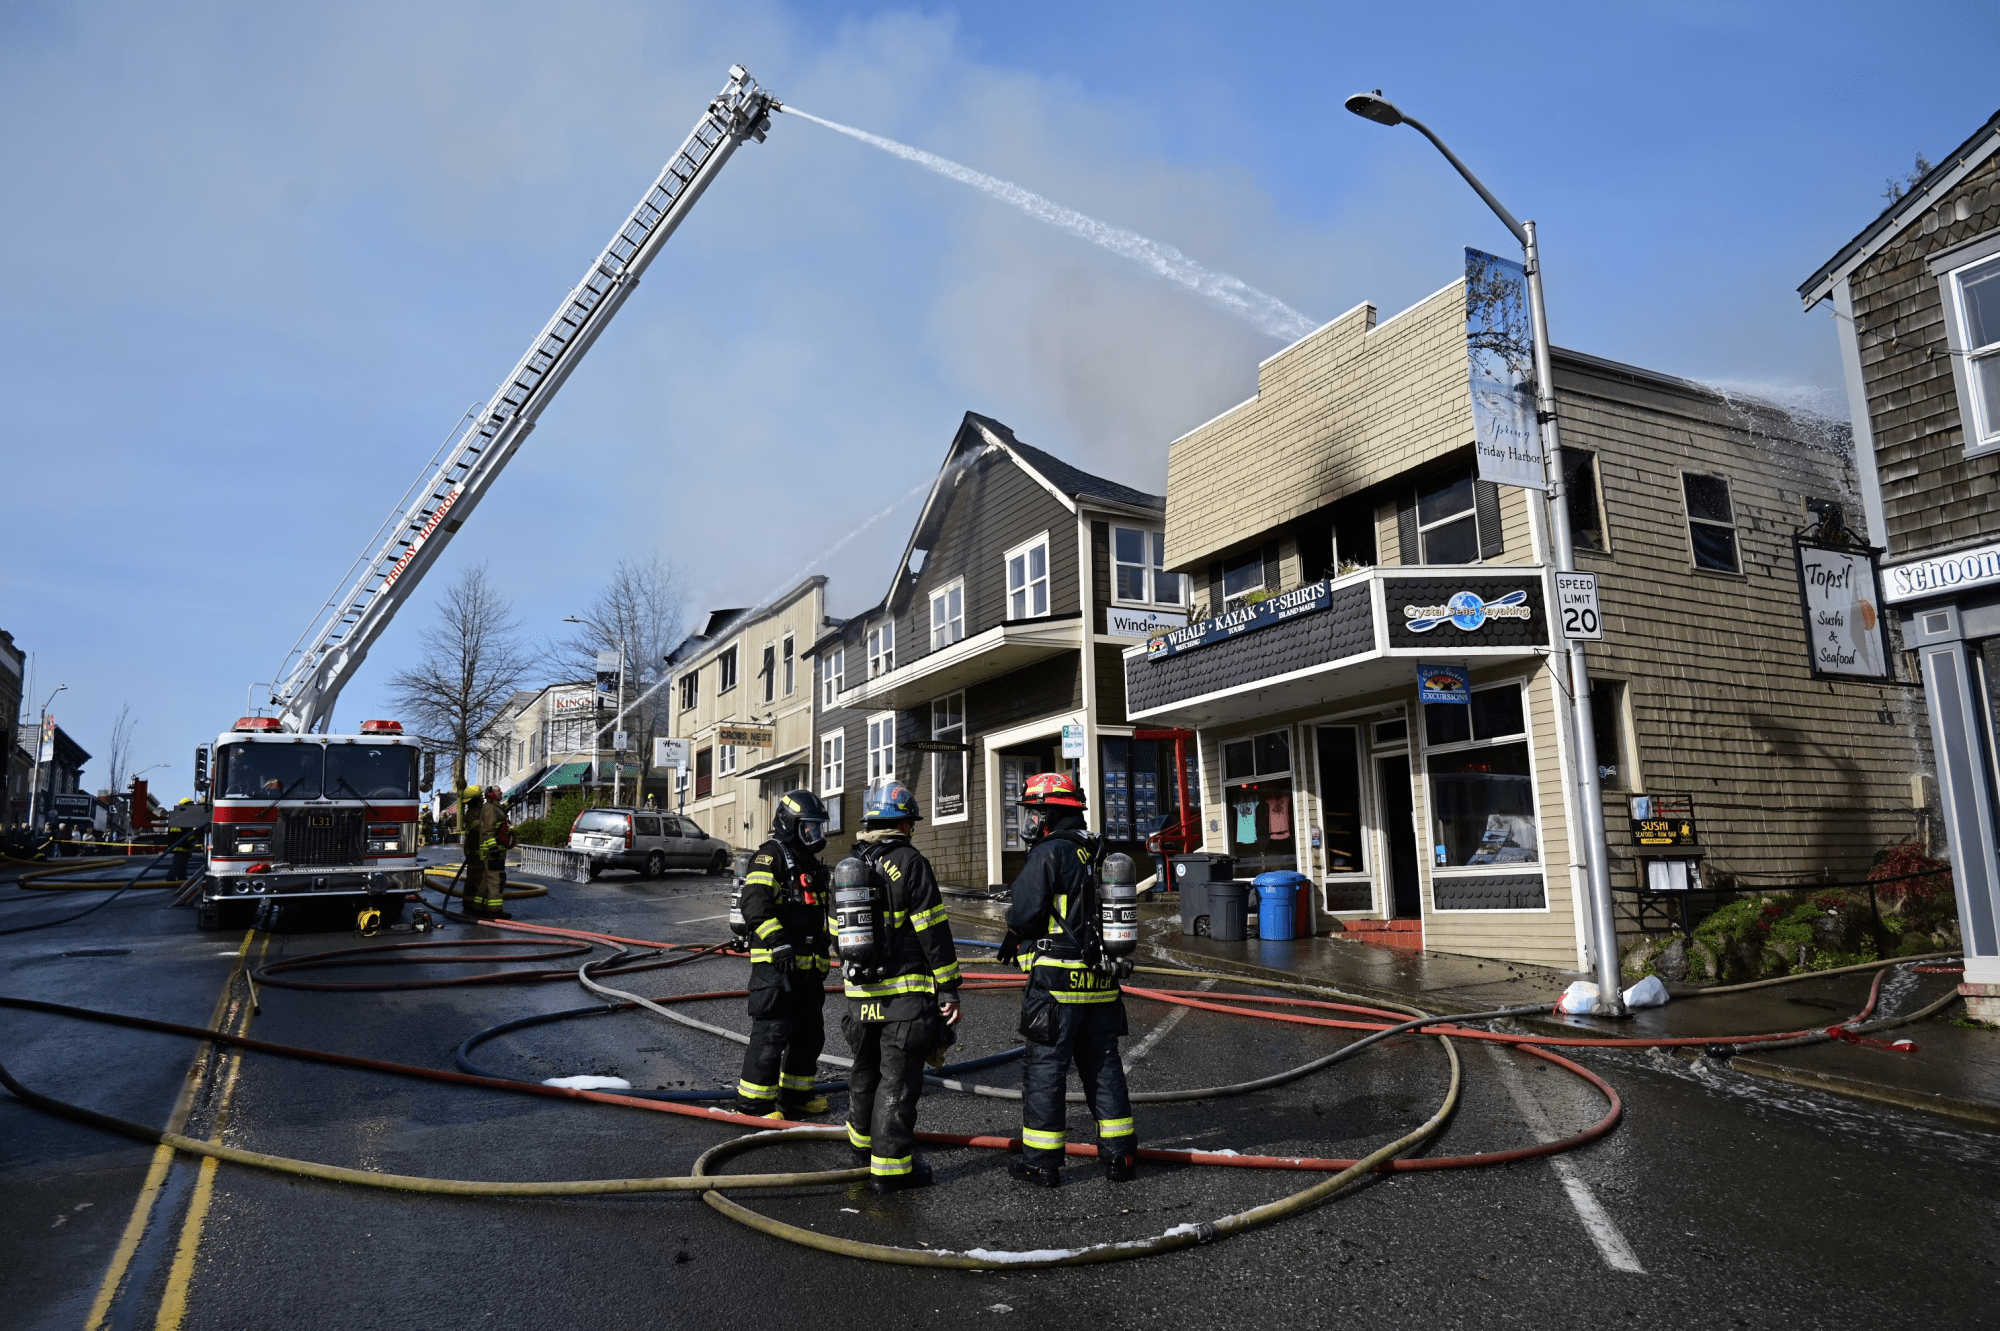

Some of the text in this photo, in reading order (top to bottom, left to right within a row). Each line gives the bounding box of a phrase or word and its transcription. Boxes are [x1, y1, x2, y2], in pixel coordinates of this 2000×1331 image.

[1482, 417, 1532, 444] Spring
[1477, 441, 1541, 463] Friday Harbor
[385, 489, 460, 586] FRIDAY HARBOR
[1895, 551, 2000, 595] Schoon
[1559, 579, 1593, 590] SPEED
[1805, 563, 1852, 599] Tops'l
[1564, 594, 1590, 604] LIMIT
[1168, 583, 1325, 645] WHALE KAYAK T-SHIRTS
[1405, 606, 1530, 619] Crystal Seas Kayaking
[1563, 607, 1597, 633] 20
[1817, 611, 1844, 627] Sushi
[1114, 617, 1184, 632] Winderm
[1175, 638, 1200, 651] WATCHING
[1228, 623, 1246, 635] TOURS
[1279, 606, 1299, 619] ISLAND
[1299, 601, 1316, 612] MADE
[1828, 631, 1838, 643] &
[1819, 646, 1857, 668] Seafood
[1423, 692, 1469, 701] EXCURSIONS
[720, 730, 773, 741] CROWS NEST
[1063, 727, 1069, 736] 2
[918, 742, 958, 750] Windermere
[312, 817, 330, 826] L31
[1641, 821, 1669, 831] SUSHI
[1635, 830, 1655, 838] SEAFOOD
[860, 1003, 885, 1021] PAL
